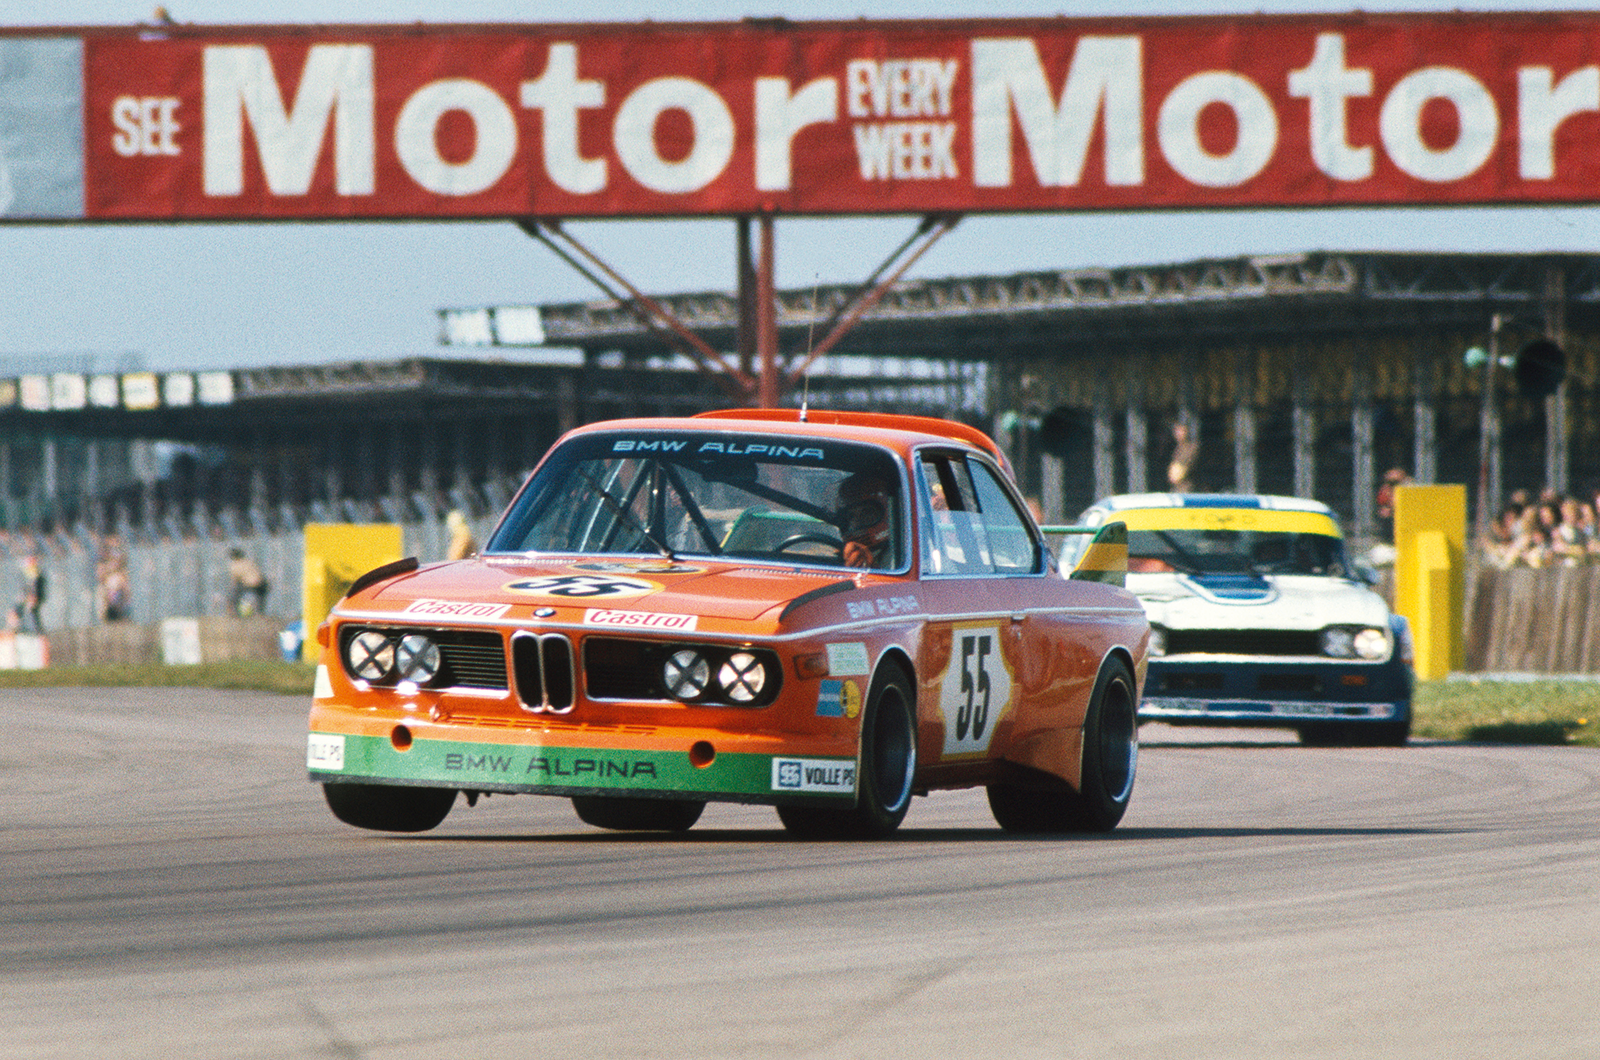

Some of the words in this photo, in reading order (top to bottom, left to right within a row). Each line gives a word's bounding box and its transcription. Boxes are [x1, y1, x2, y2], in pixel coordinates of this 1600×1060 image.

[847, 58, 959, 117] EVERY
[112, 96, 181, 156] SEE
[202, 42, 839, 196] Motor
[971, 33, 1600, 187] Motor
[853, 122, 959, 180] WEEK
[612, 440, 688, 452] BMW
[699, 442, 825, 459] ALPINA
[508, 575, 653, 598] 55
[409, 601, 507, 617] Castrol
[589, 610, 692, 629] Castrol
[956, 635, 991, 741] 55
[446, 753, 513, 772] BMW
[527, 757, 658, 779] ALPINA
[805, 767, 841, 786] VOLLE
